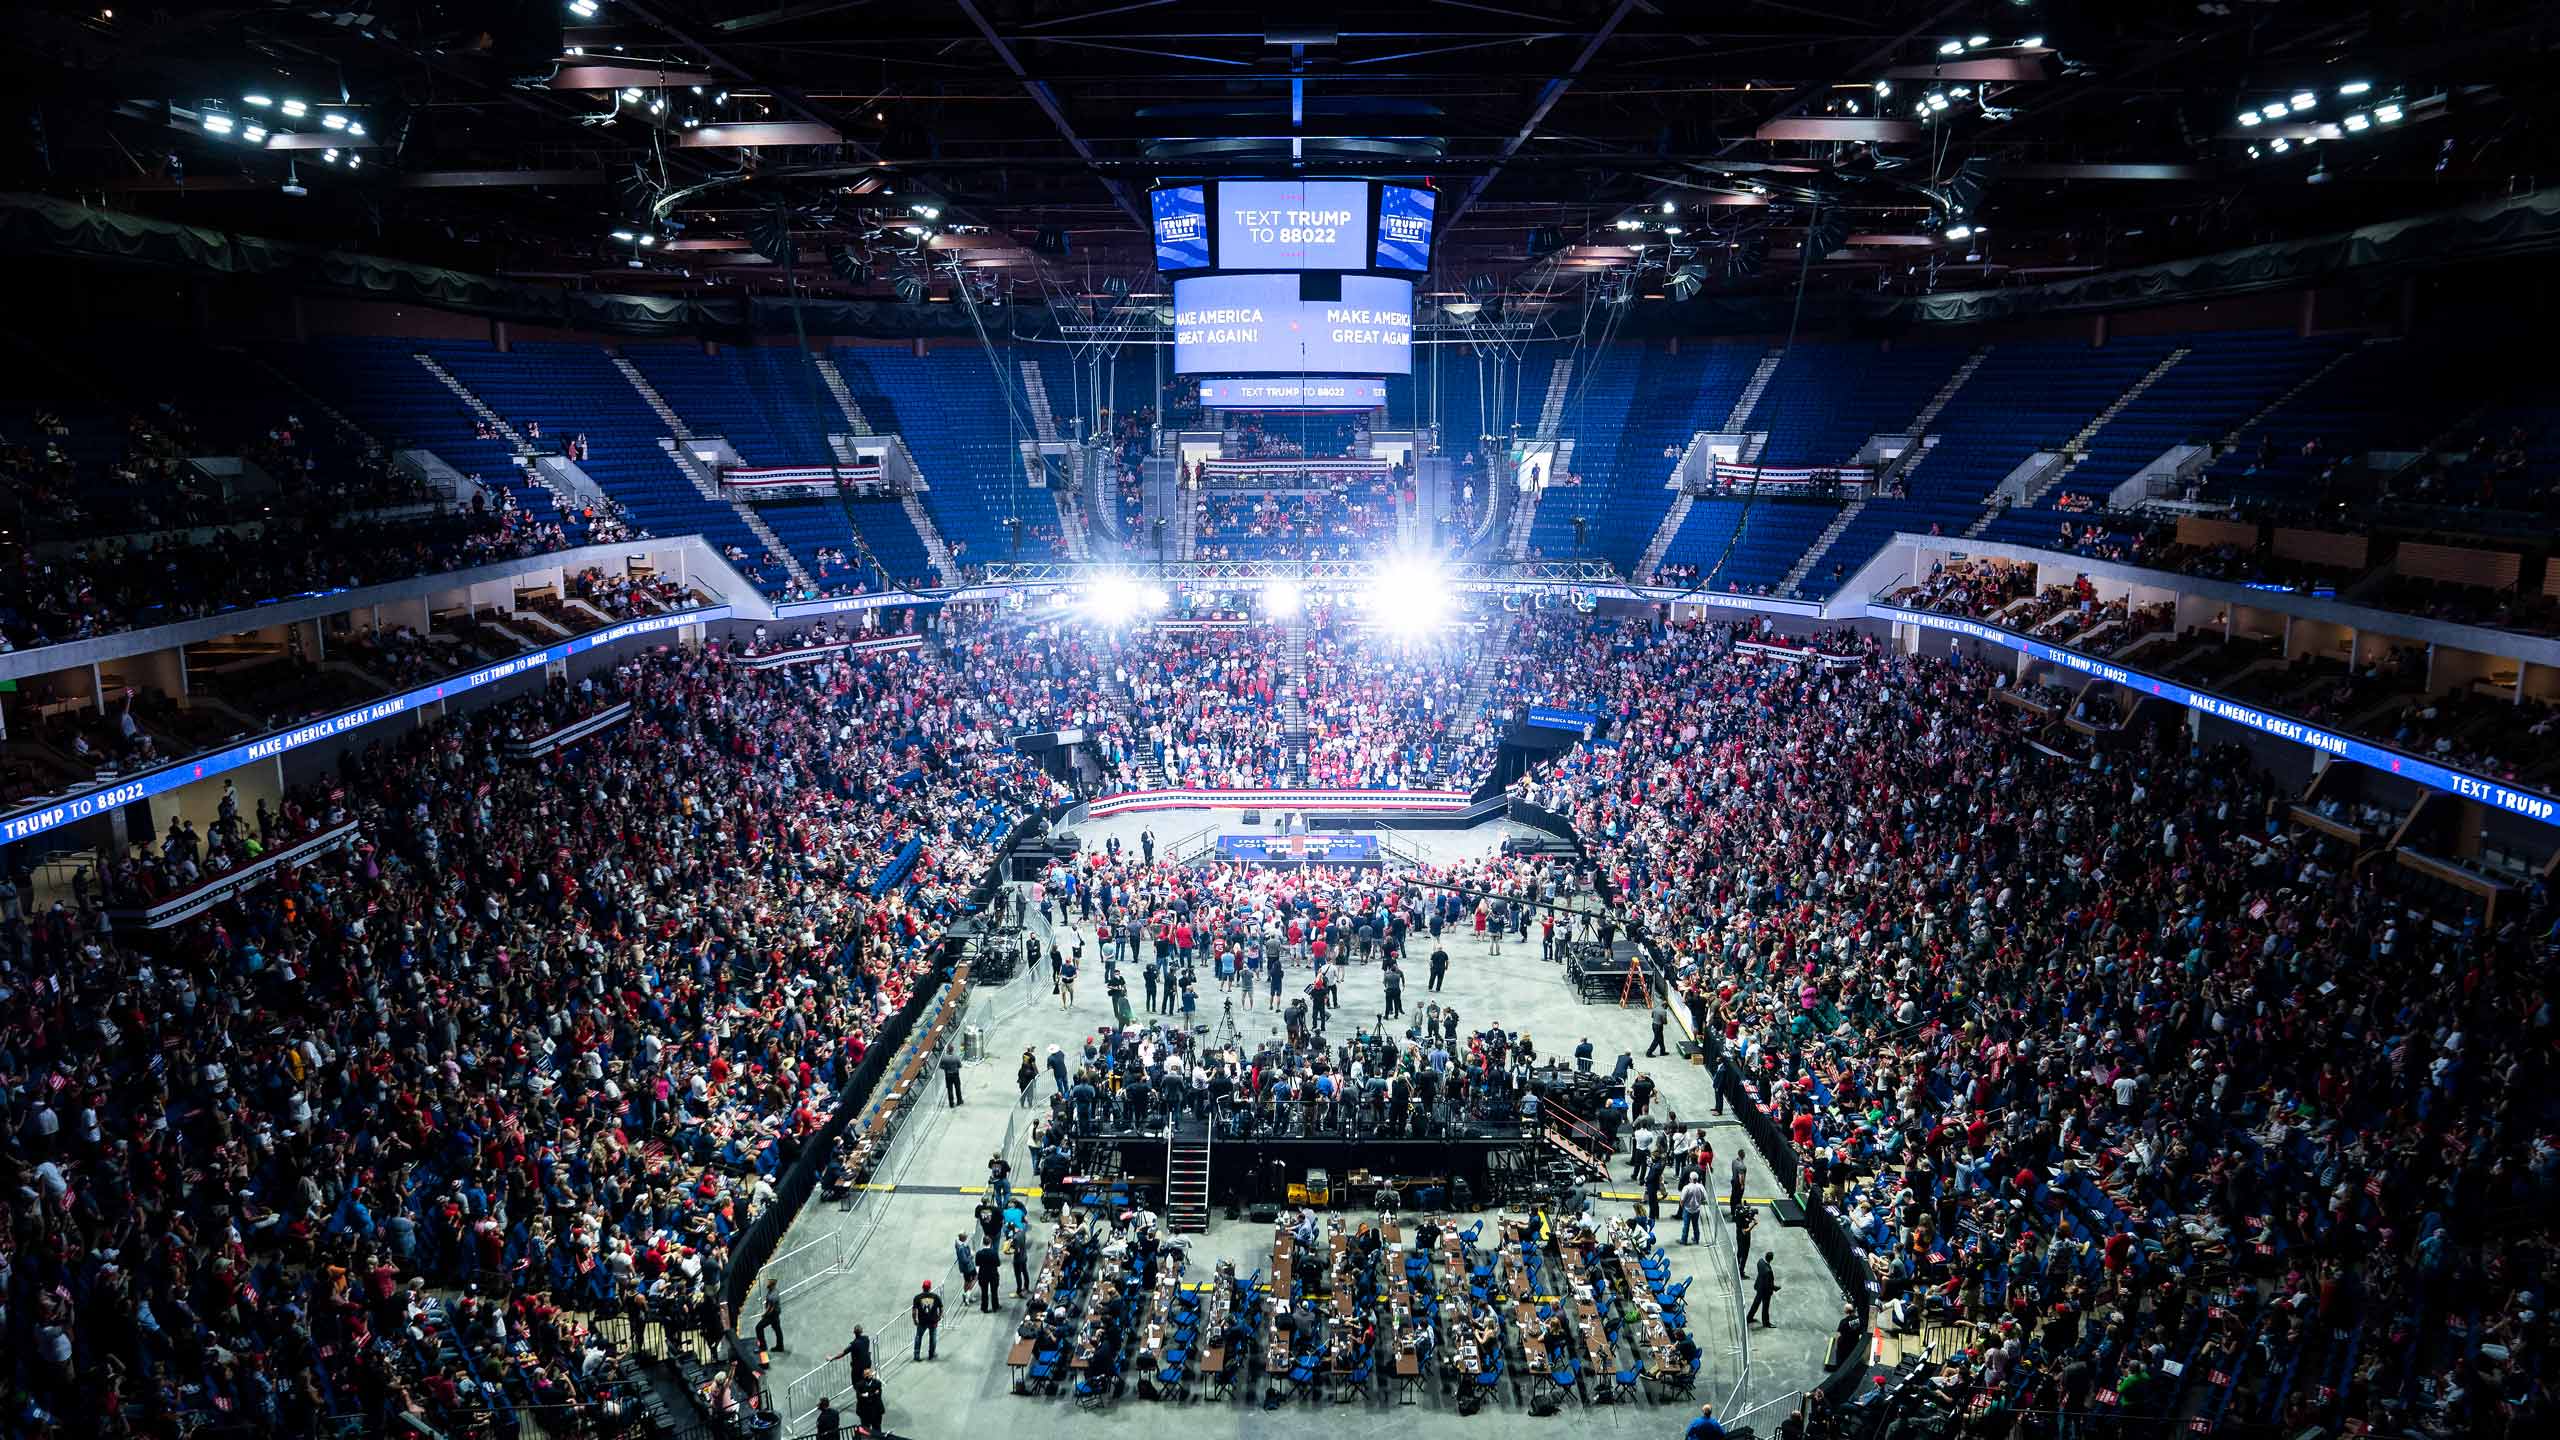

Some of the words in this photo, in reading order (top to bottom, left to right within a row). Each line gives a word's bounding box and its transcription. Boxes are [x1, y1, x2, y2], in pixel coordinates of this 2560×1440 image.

[1162, 216, 1197, 229] TRUMP
[1235, 211, 1282, 225] TEXT
[1287, 211, 1351, 226] TRUMP
[1390, 218, 1424, 230] TRUMP
[1249, 229, 1273, 243] TO
[1280, 229, 1336, 243] 88022
[1199, 309, 1263, 325] AMERICA
[1328, 310, 1370, 325] MAKE
[1374, 311, 1411, 328] AMERICA
[1178, 330, 1205, 345] GREAT
[1207, 329, 1258, 344] AGAIN!
[1332, 330, 1378, 344] GREAT
[1241, 388, 1264, 397] TEXT
[1266, 387, 1299, 397] TRUMP
[1303, 387, 1316, 397] TO
[833, 601, 859, 611] MAKE
[863, 594, 906, 607] AMERICA
[1597, 588, 1626, 599] MAKE
[1683, 593, 1715, 605] GREAT
[1719, 599, 1752, 609] AGAIN!
[637, 620, 665, 632] GREAT
[668, 614, 697, 626] AGAIN!
[1896, 612, 1919, 624] MAKE
[1921, 616, 1959, 632] AMERICA
[1963, 623, 1984, 636] GREAT
[1984, 628, 2005, 643] AGAIN!
[470, 671, 489, 686] TEXT
[491, 663, 515, 679] TRUMP
[516, 660, 526, 669] TO
[2049, 649, 2066, 663] TEXT
[2067, 655, 2090, 671] TRUMP
[2092, 663, 2102, 675] TO
[2103, 667, 2128, 684] 88022
[248, 738, 281, 760] MAKE
[285, 724, 334, 749] AMERICA
[337, 709, 369, 730] GREAT
[372, 699, 404, 719] AGAIN!
[2190, 693, 2216, 712] MAKE
[2218, 703, 2262, 727] AMERICA
[2266, 718, 2302, 739] GREAT
[2305, 731, 2348, 754] AGAIN!
[2452, 775, 2491, 800] TEXT
[2496, 789, 2553, 819] TRUMP
[5, 809, 64, 838] TRUMP
[70, 800, 92, 818] TO
[97, 783, 145, 809] 88022
